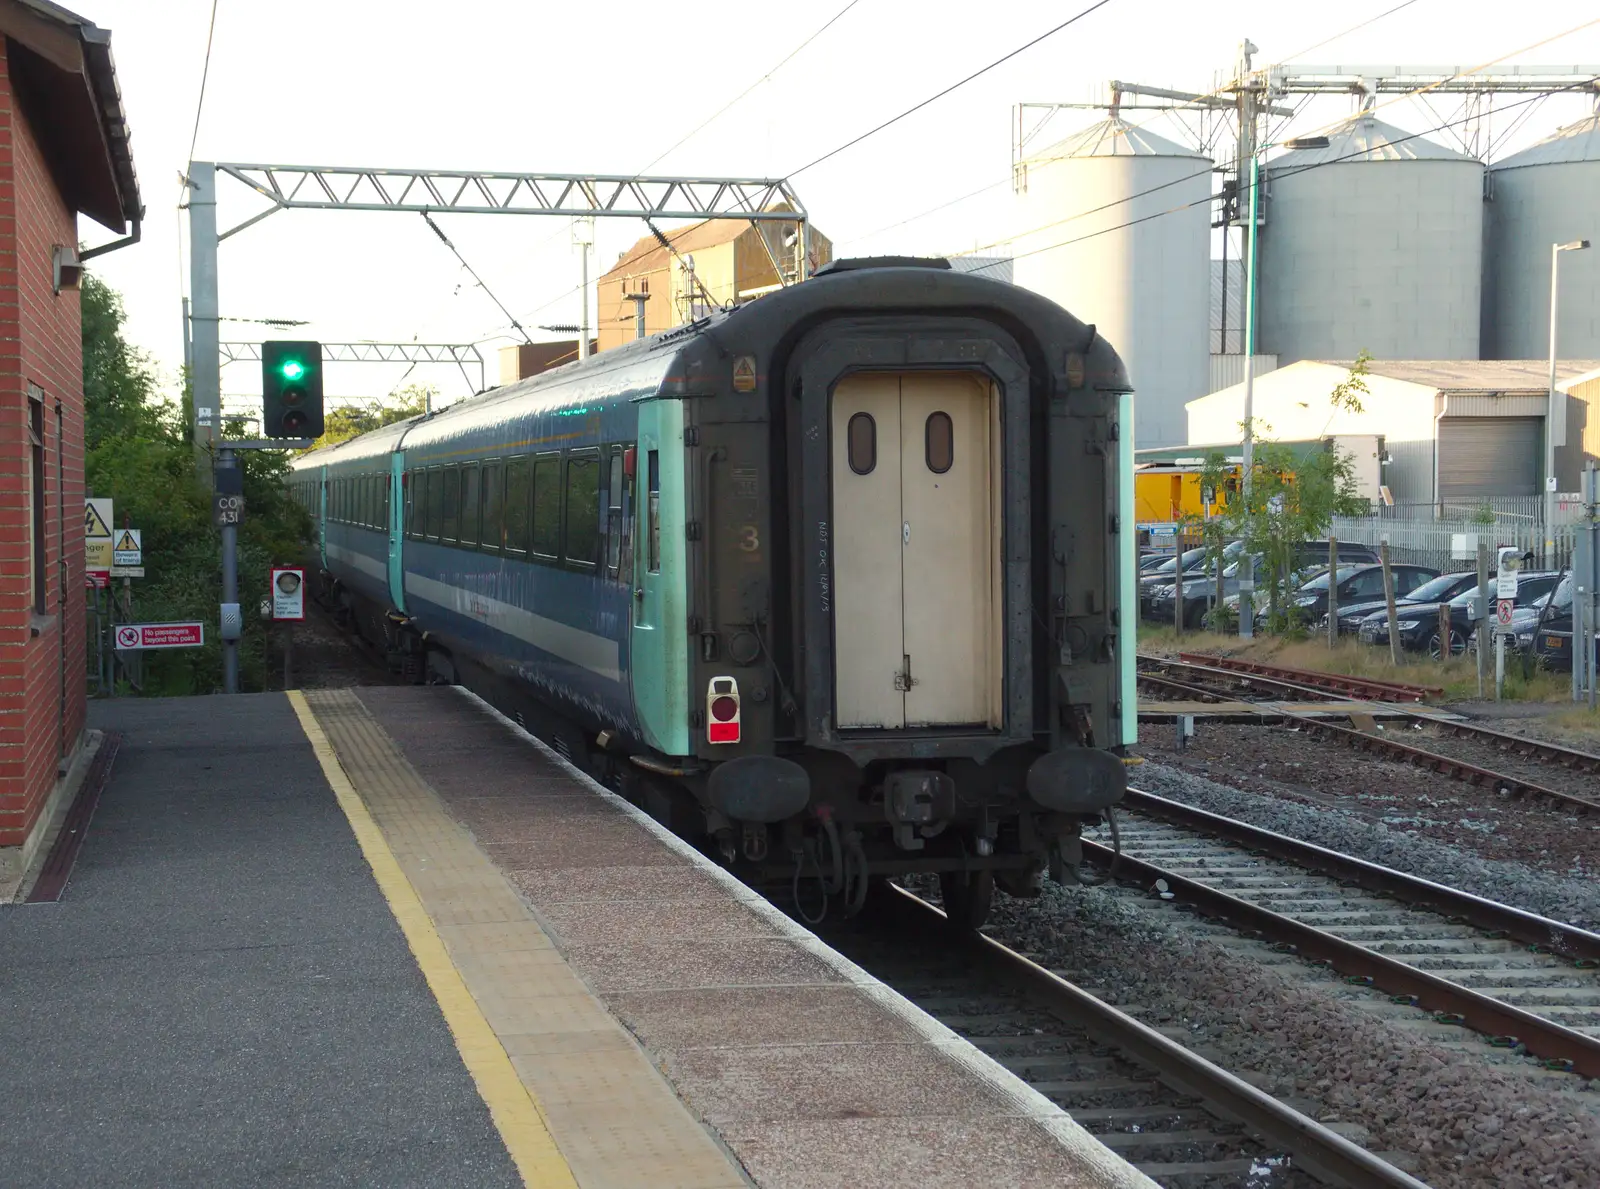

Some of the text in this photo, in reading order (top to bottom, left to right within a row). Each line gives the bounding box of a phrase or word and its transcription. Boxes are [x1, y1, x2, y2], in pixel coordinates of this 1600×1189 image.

[219, 497, 238, 509] CO
[219, 511, 239, 523] 431
[740, 525, 759, 551] 3
[85, 544, 105, 552] nger
[154, 628, 189, 638] passengers
[144, 635, 167, 644] beyond
[180, 634, 196, 643] point
